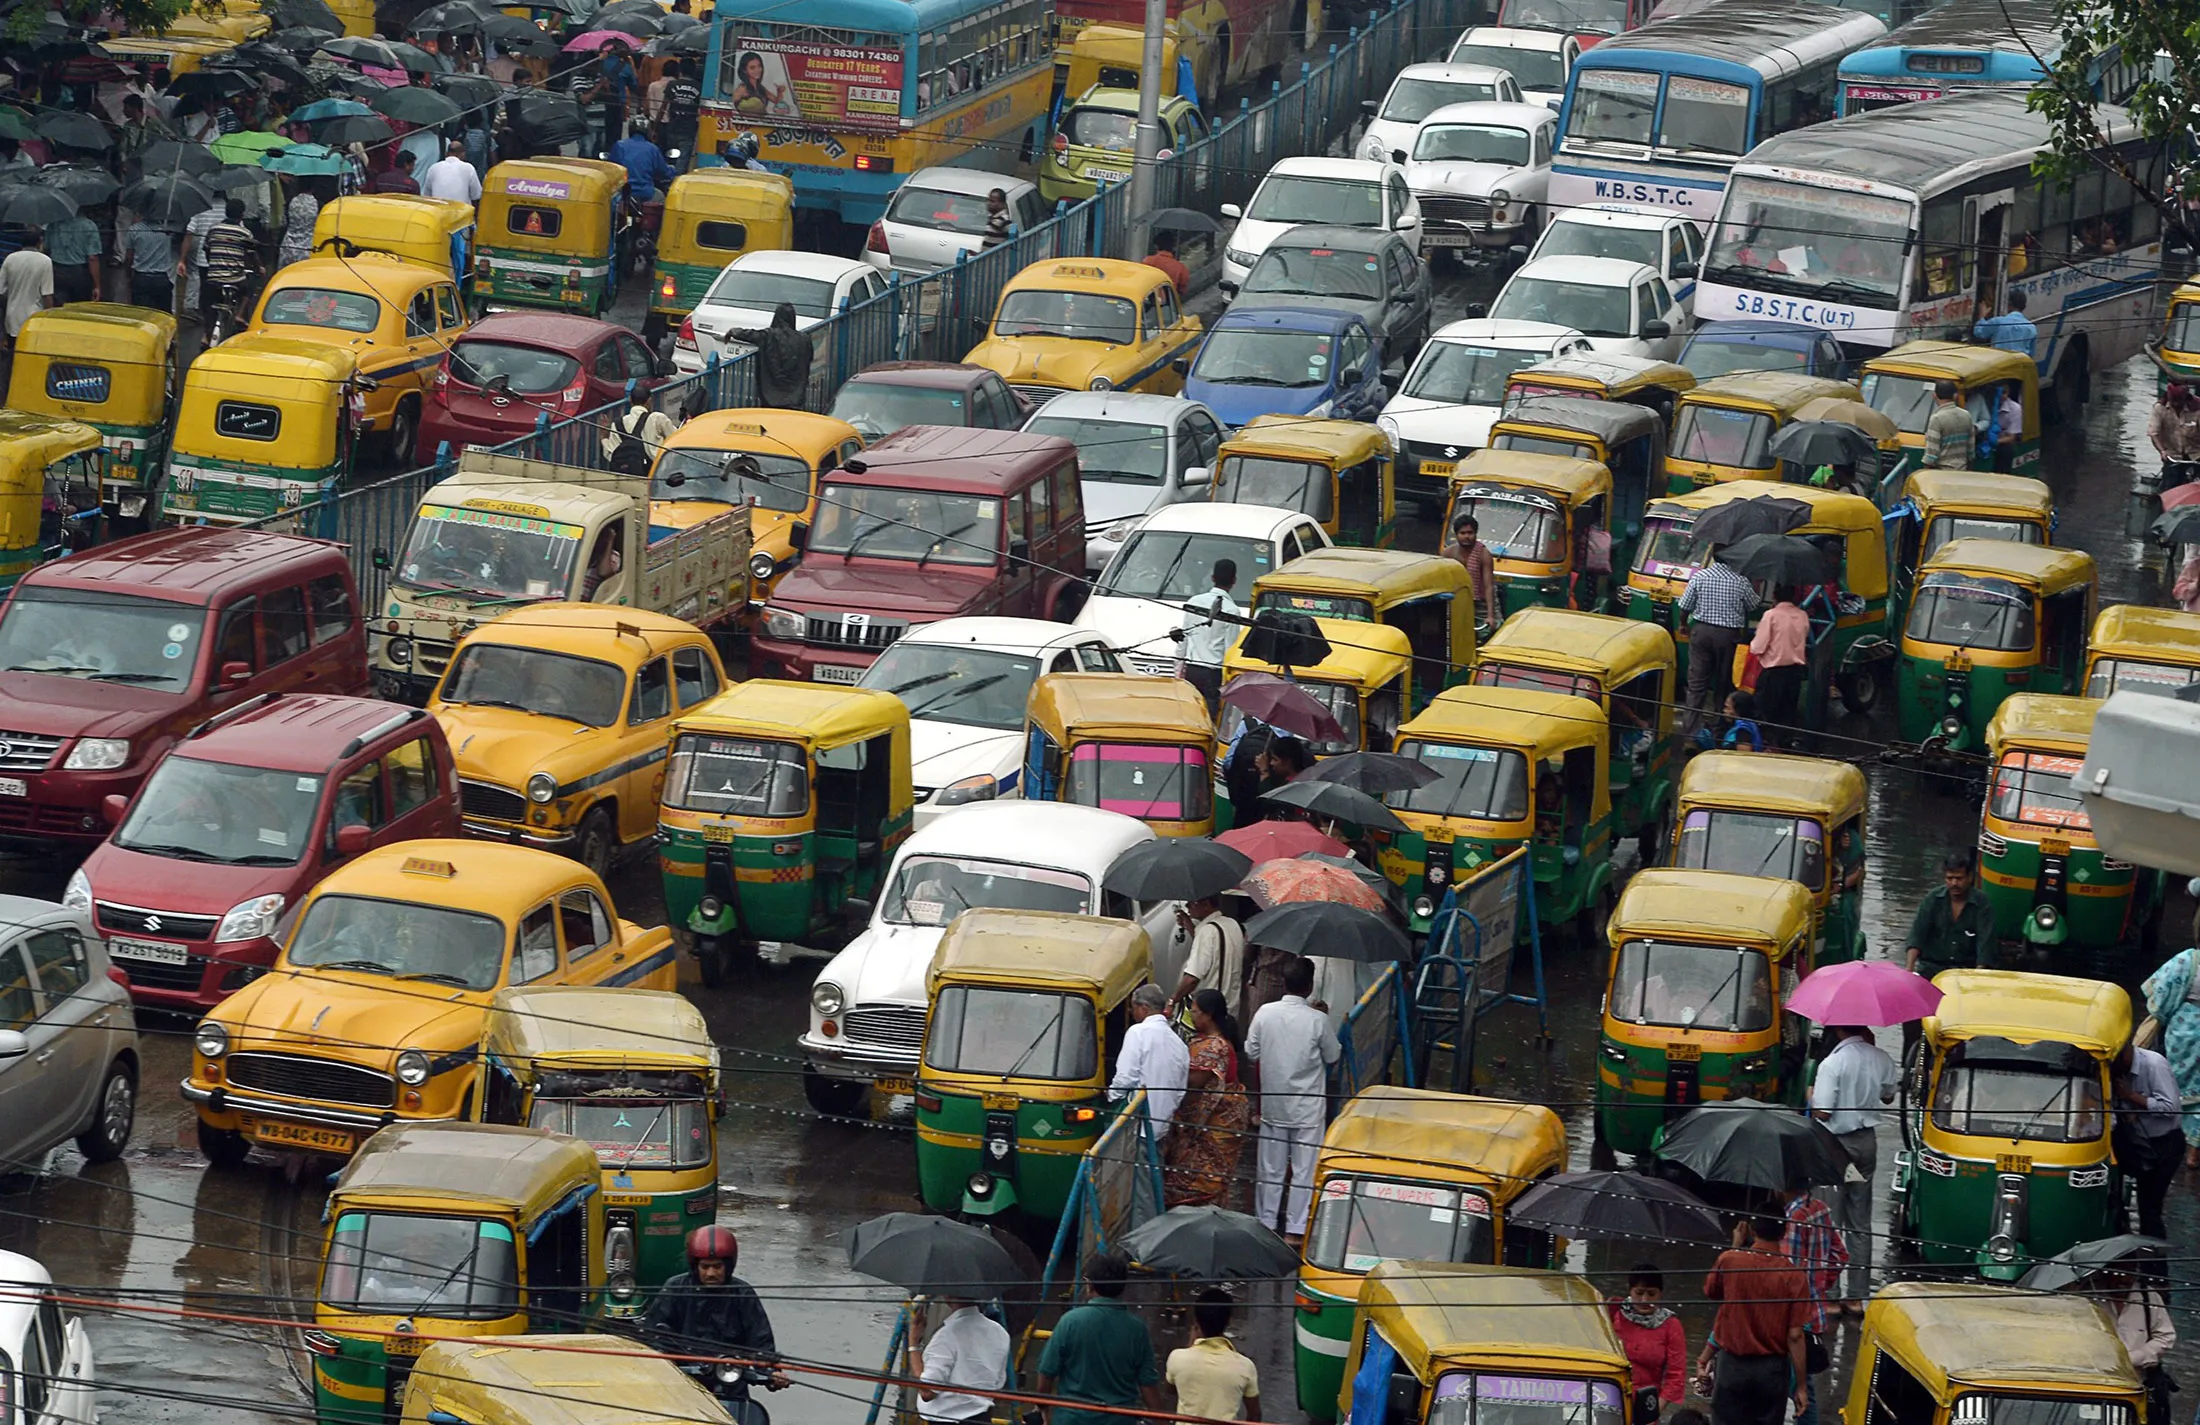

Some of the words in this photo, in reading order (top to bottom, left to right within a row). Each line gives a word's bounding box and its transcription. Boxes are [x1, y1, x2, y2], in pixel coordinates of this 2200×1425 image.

[742, 40, 821, 57] KANKURGACHI
[833, 48, 866, 60] 98301
[868, 51, 900, 62] 74360
[806, 60, 845, 70] DEDICATED
[846, 62, 855, 71] 17
[856, 62, 881, 74] YEARS
[849, 88, 898, 102] ARENA
[846, 112, 900, 123] KANKURGACHI
[1596, 181, 1692, 206] W.B.S.T.C.
[1060, 267, 1096, 277] TAXI
[56, 376, 104, 391] CHINKI
[495, 504, 541, 515] CARRIAGE
[458, 511, 481, 522] JAI
[487, 514, 521, 528] MATA
[527, 521, 541, 531] DI
[410, 860, 444, 872] TAXI
[1499, 1378, 1566, 1400] TANMOY
